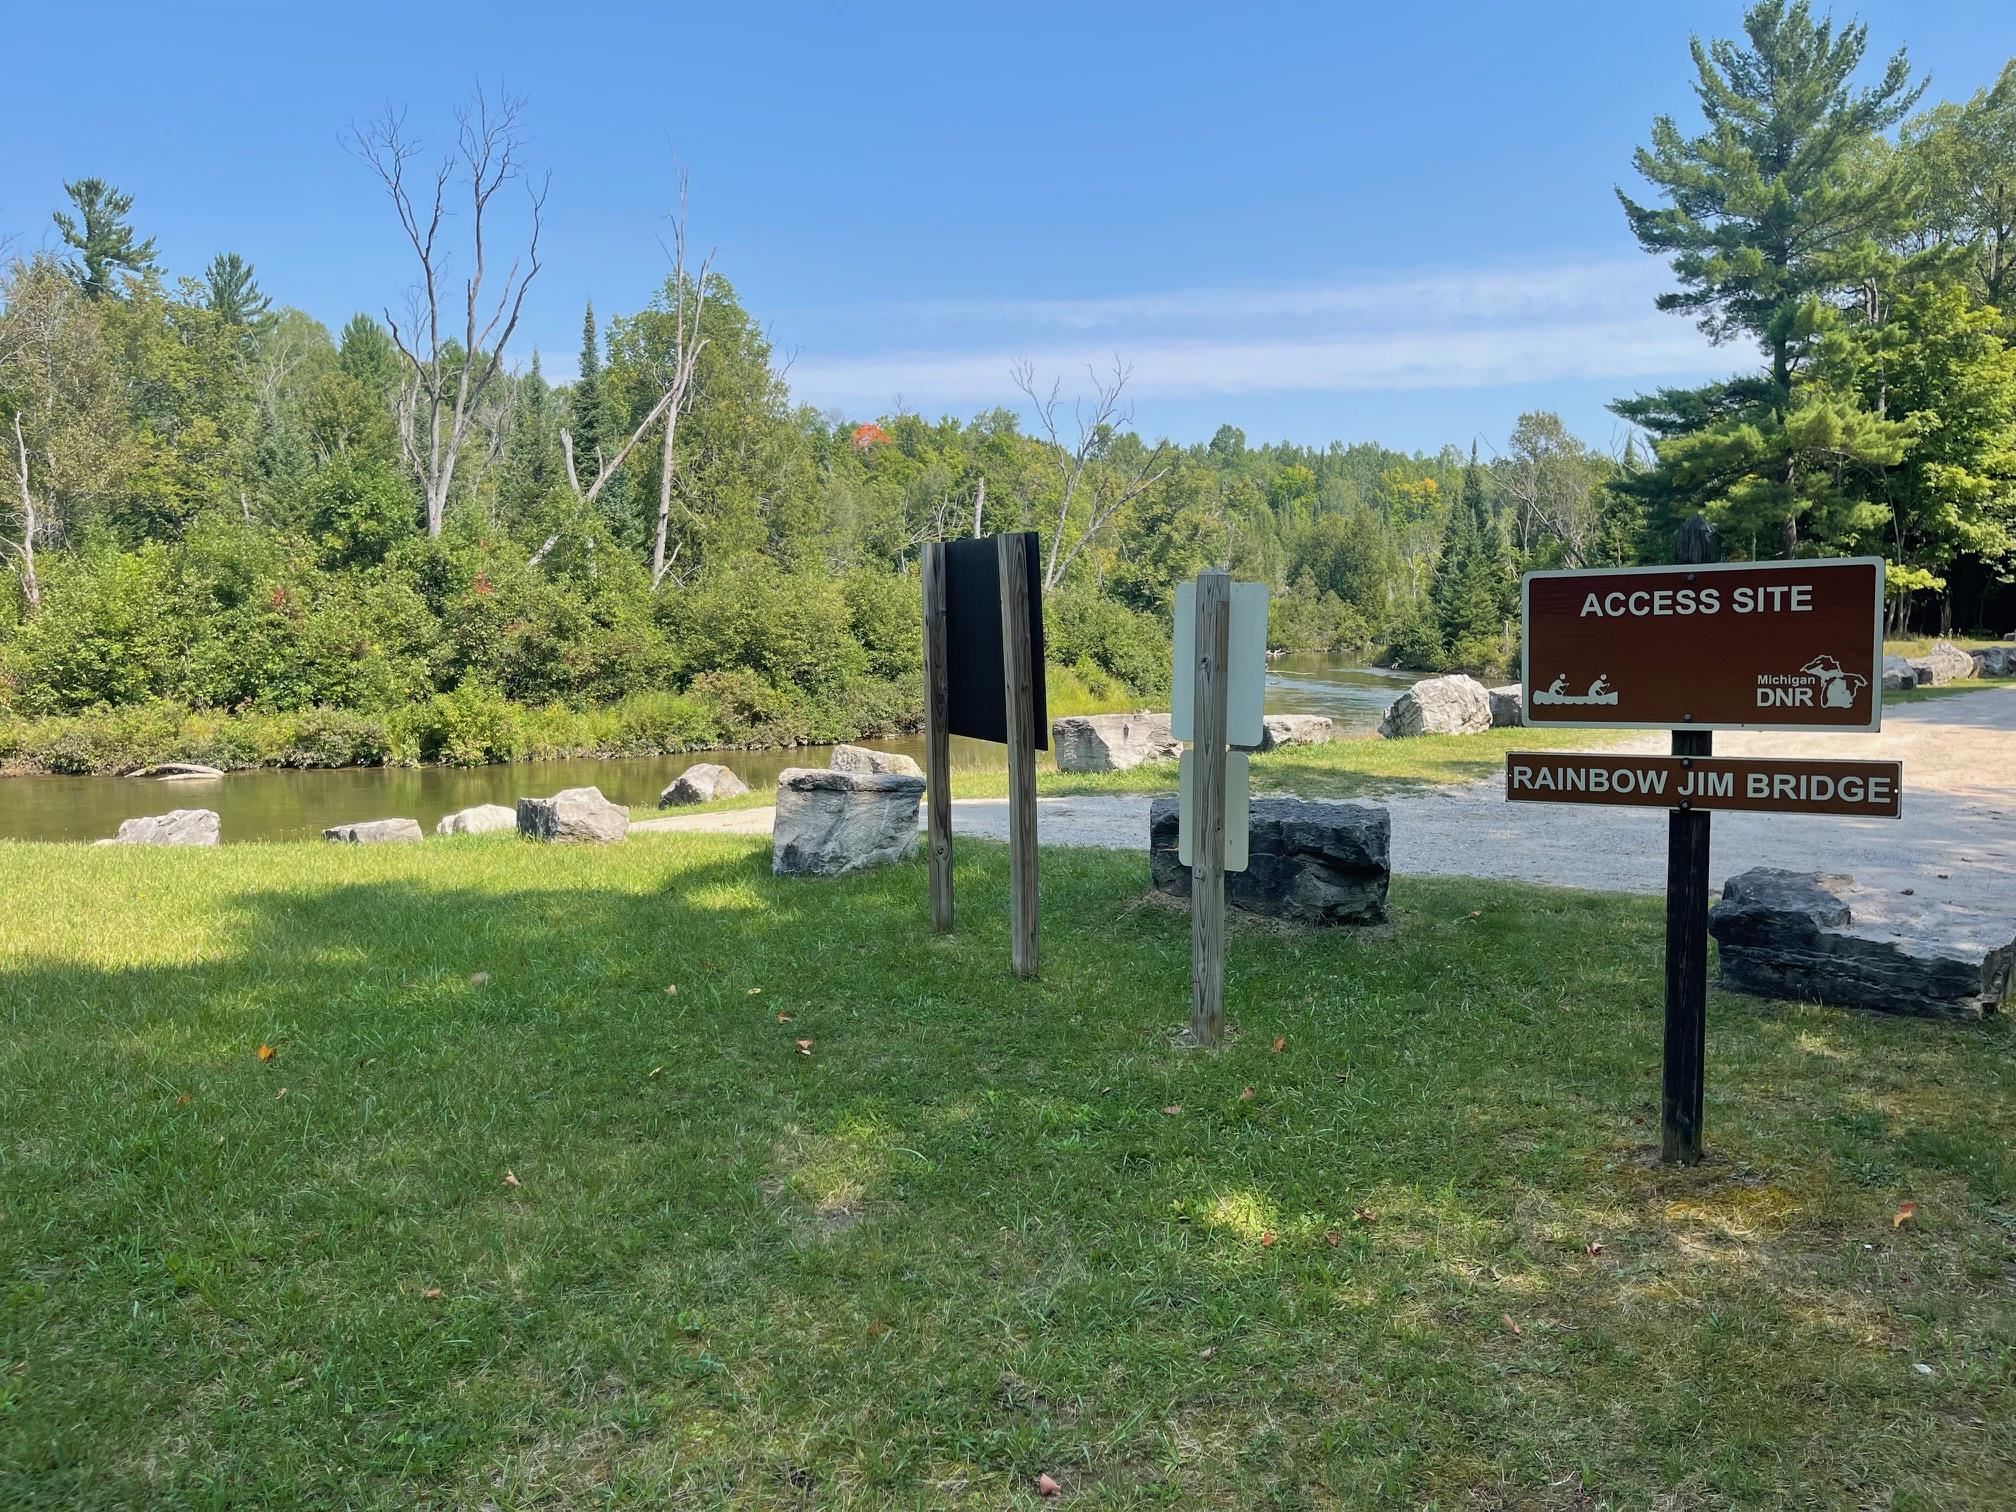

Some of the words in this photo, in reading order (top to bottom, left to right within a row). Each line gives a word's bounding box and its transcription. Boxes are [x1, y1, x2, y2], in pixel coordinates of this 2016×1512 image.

[1580, 588, 1720, 618] ACCESS
[1733, 585, 1814, 614] SITE
[1757, 674, 1816, 687] Michigan
[1757, 687, 1814, 707] DNR
[1513, 766, 1668, 795] RAINBOW
[1678, 770, 1734, 797] JIM
[1746, 773, 1891, 804] BRIDGE
